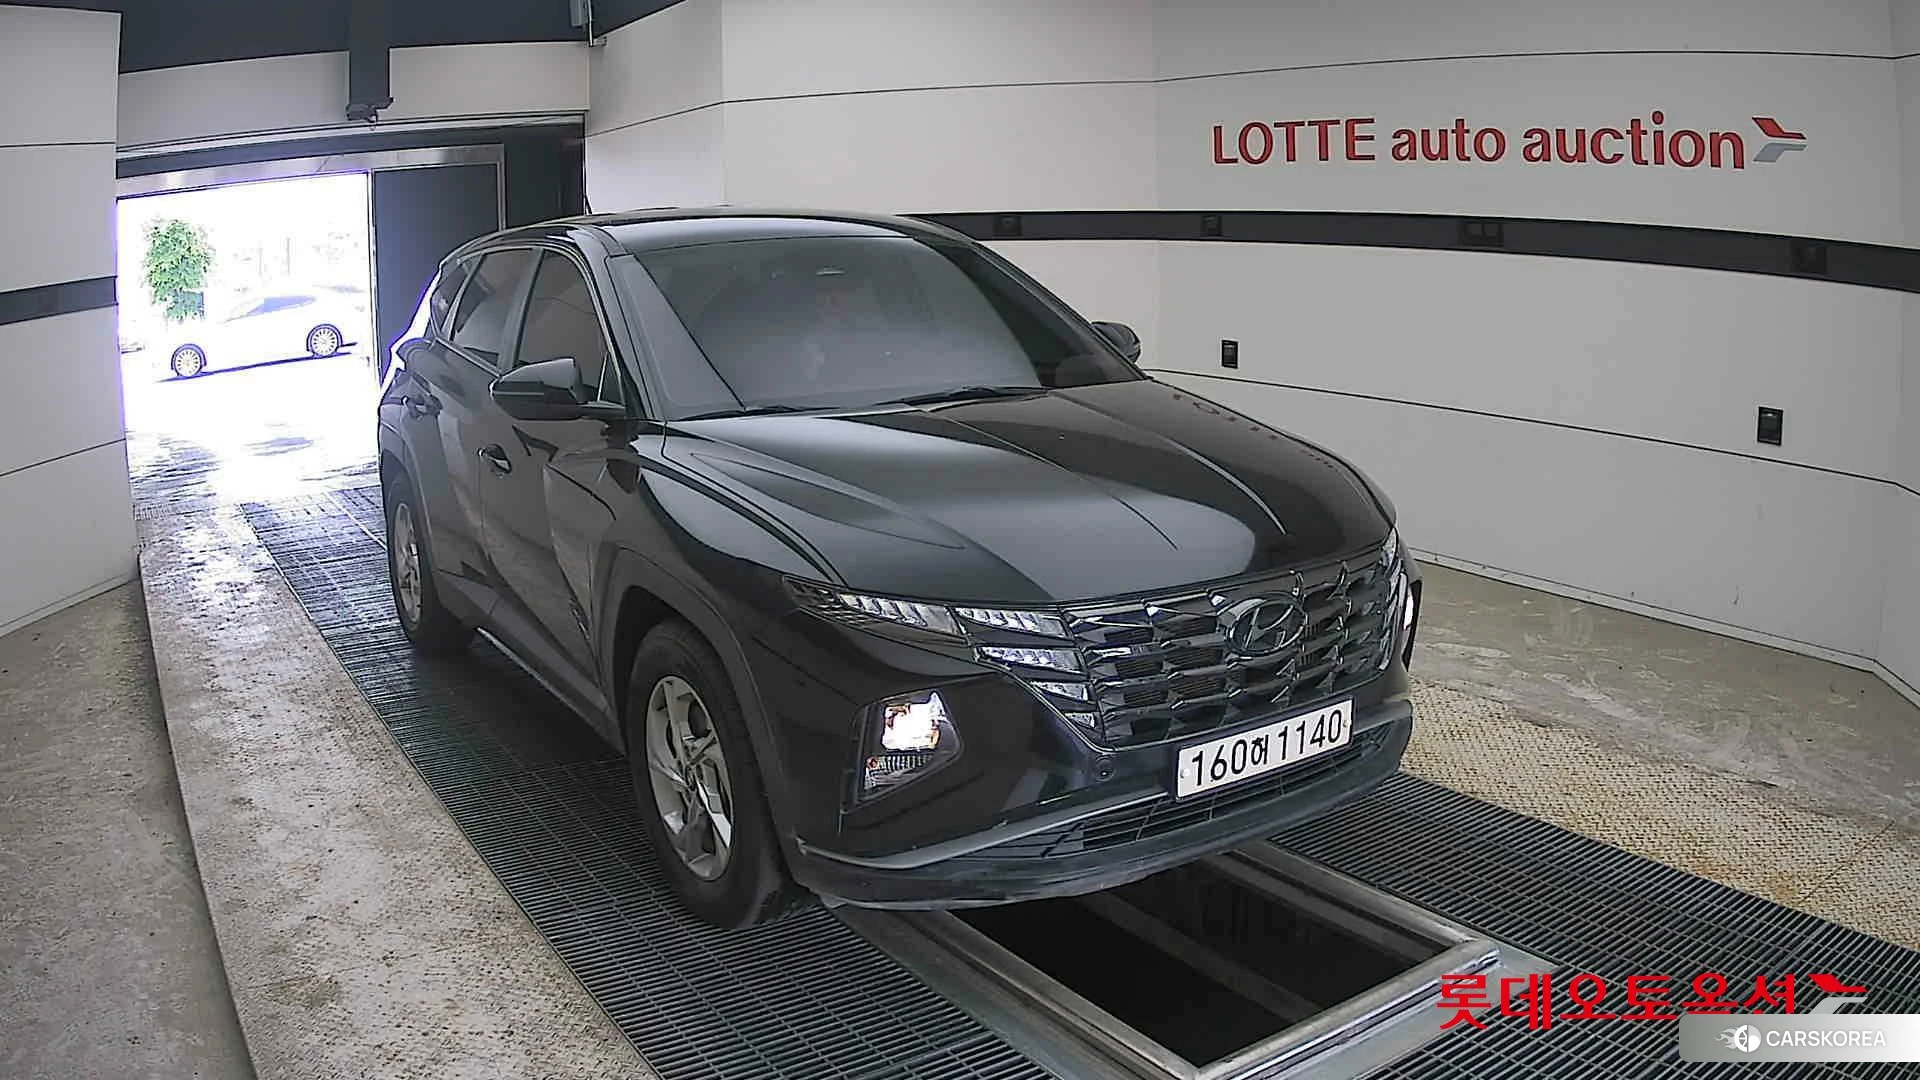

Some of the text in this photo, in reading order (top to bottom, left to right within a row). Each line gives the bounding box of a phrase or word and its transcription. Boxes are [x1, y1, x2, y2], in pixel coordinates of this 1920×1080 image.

[1212, 110, 1745, 169] LOTTE auto auction
